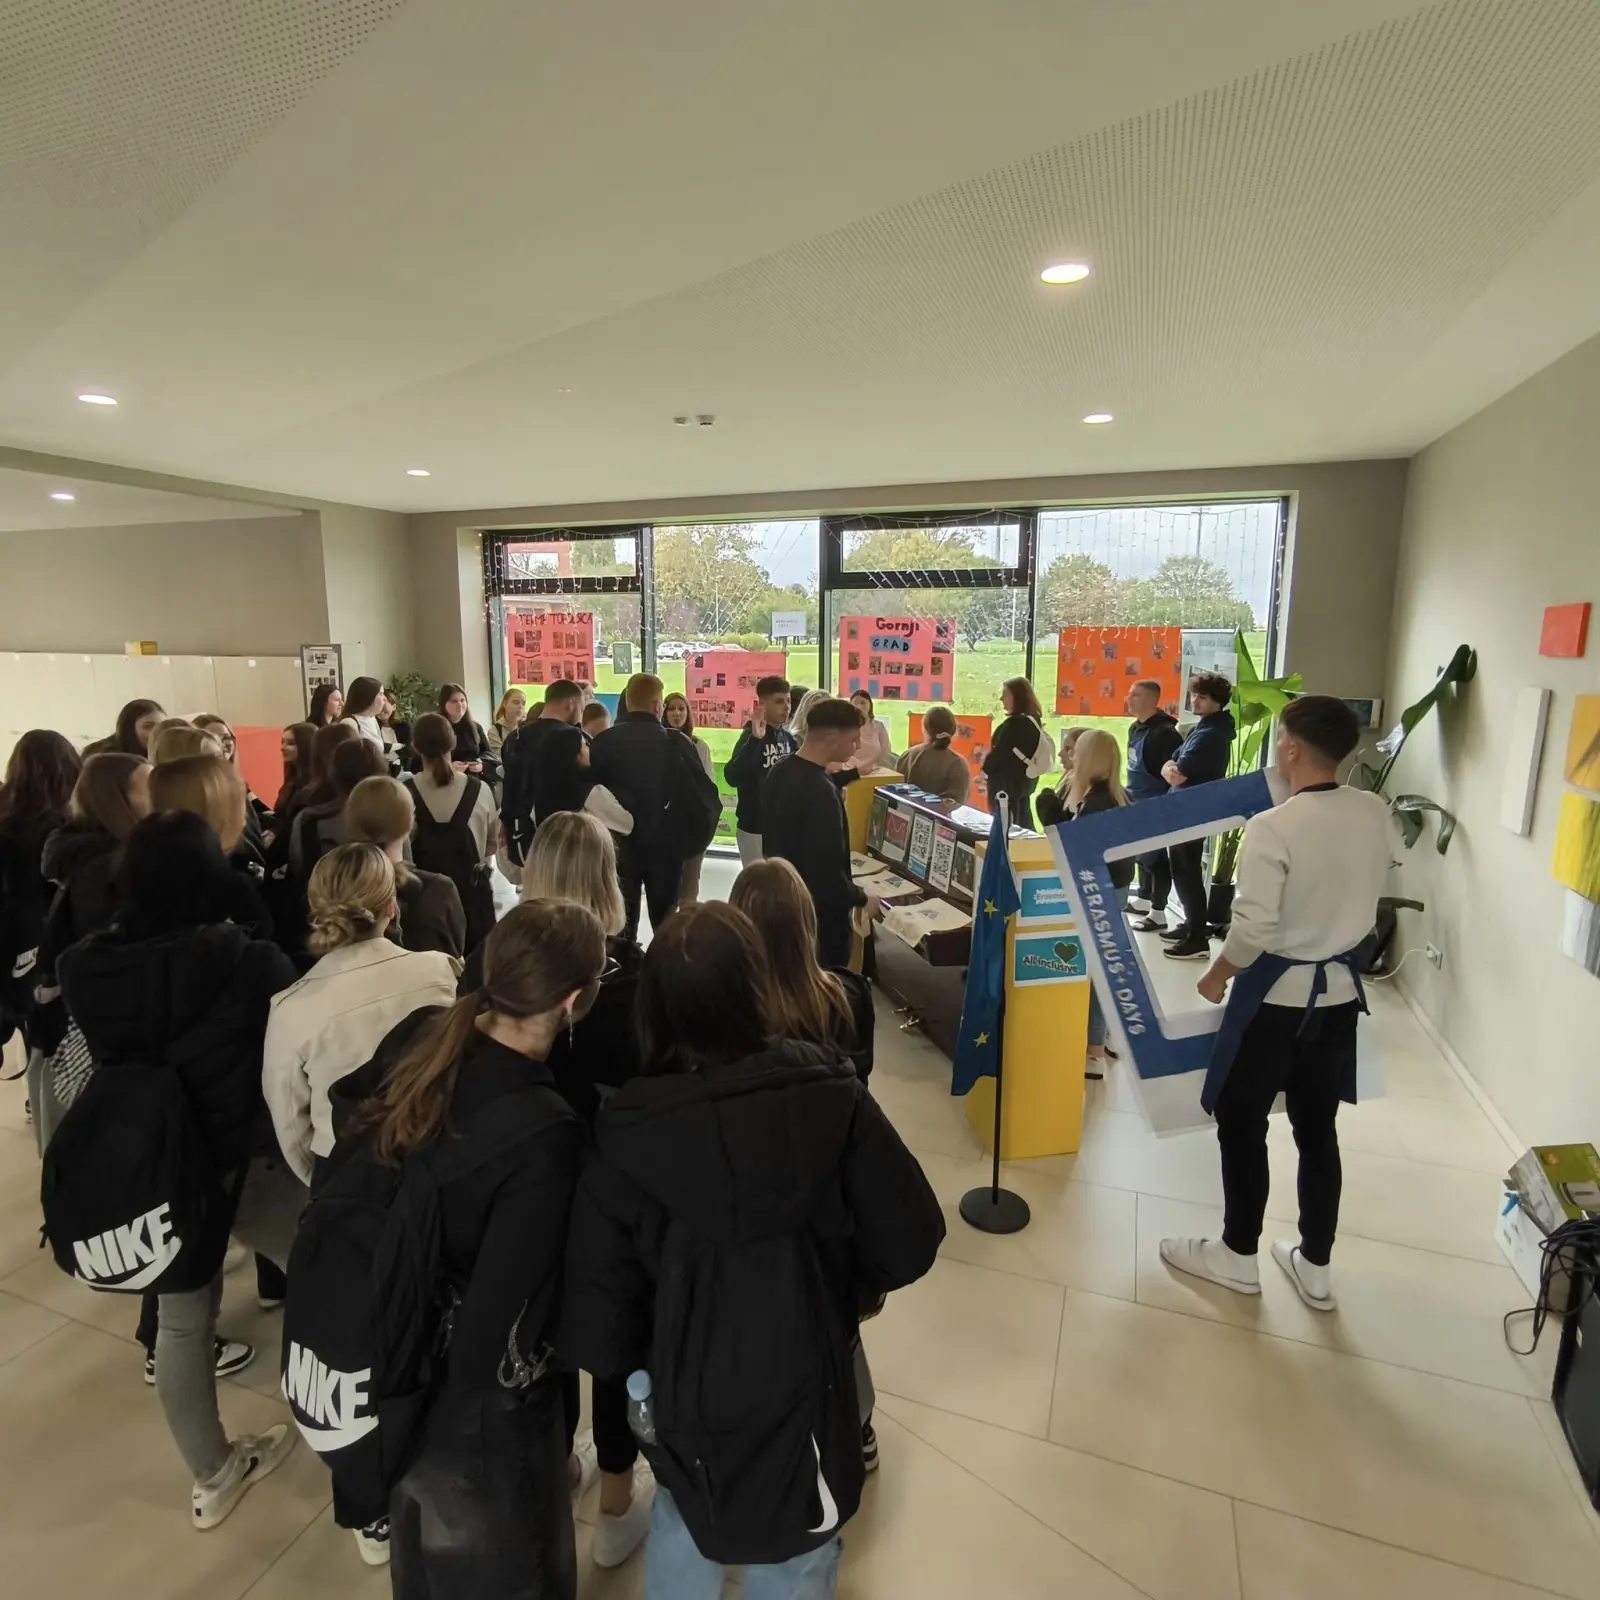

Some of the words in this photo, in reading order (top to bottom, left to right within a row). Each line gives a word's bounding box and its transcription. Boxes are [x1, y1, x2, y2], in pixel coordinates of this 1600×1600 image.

[872, 638, 910, 652] GRAD
[876, 617, 919, 637] Gornji
[1116, 987, 1146, 1036] DAYS
[73, 1201, 178, 1280] NIKE
[289, 1339, 374, 1430] NIKE
